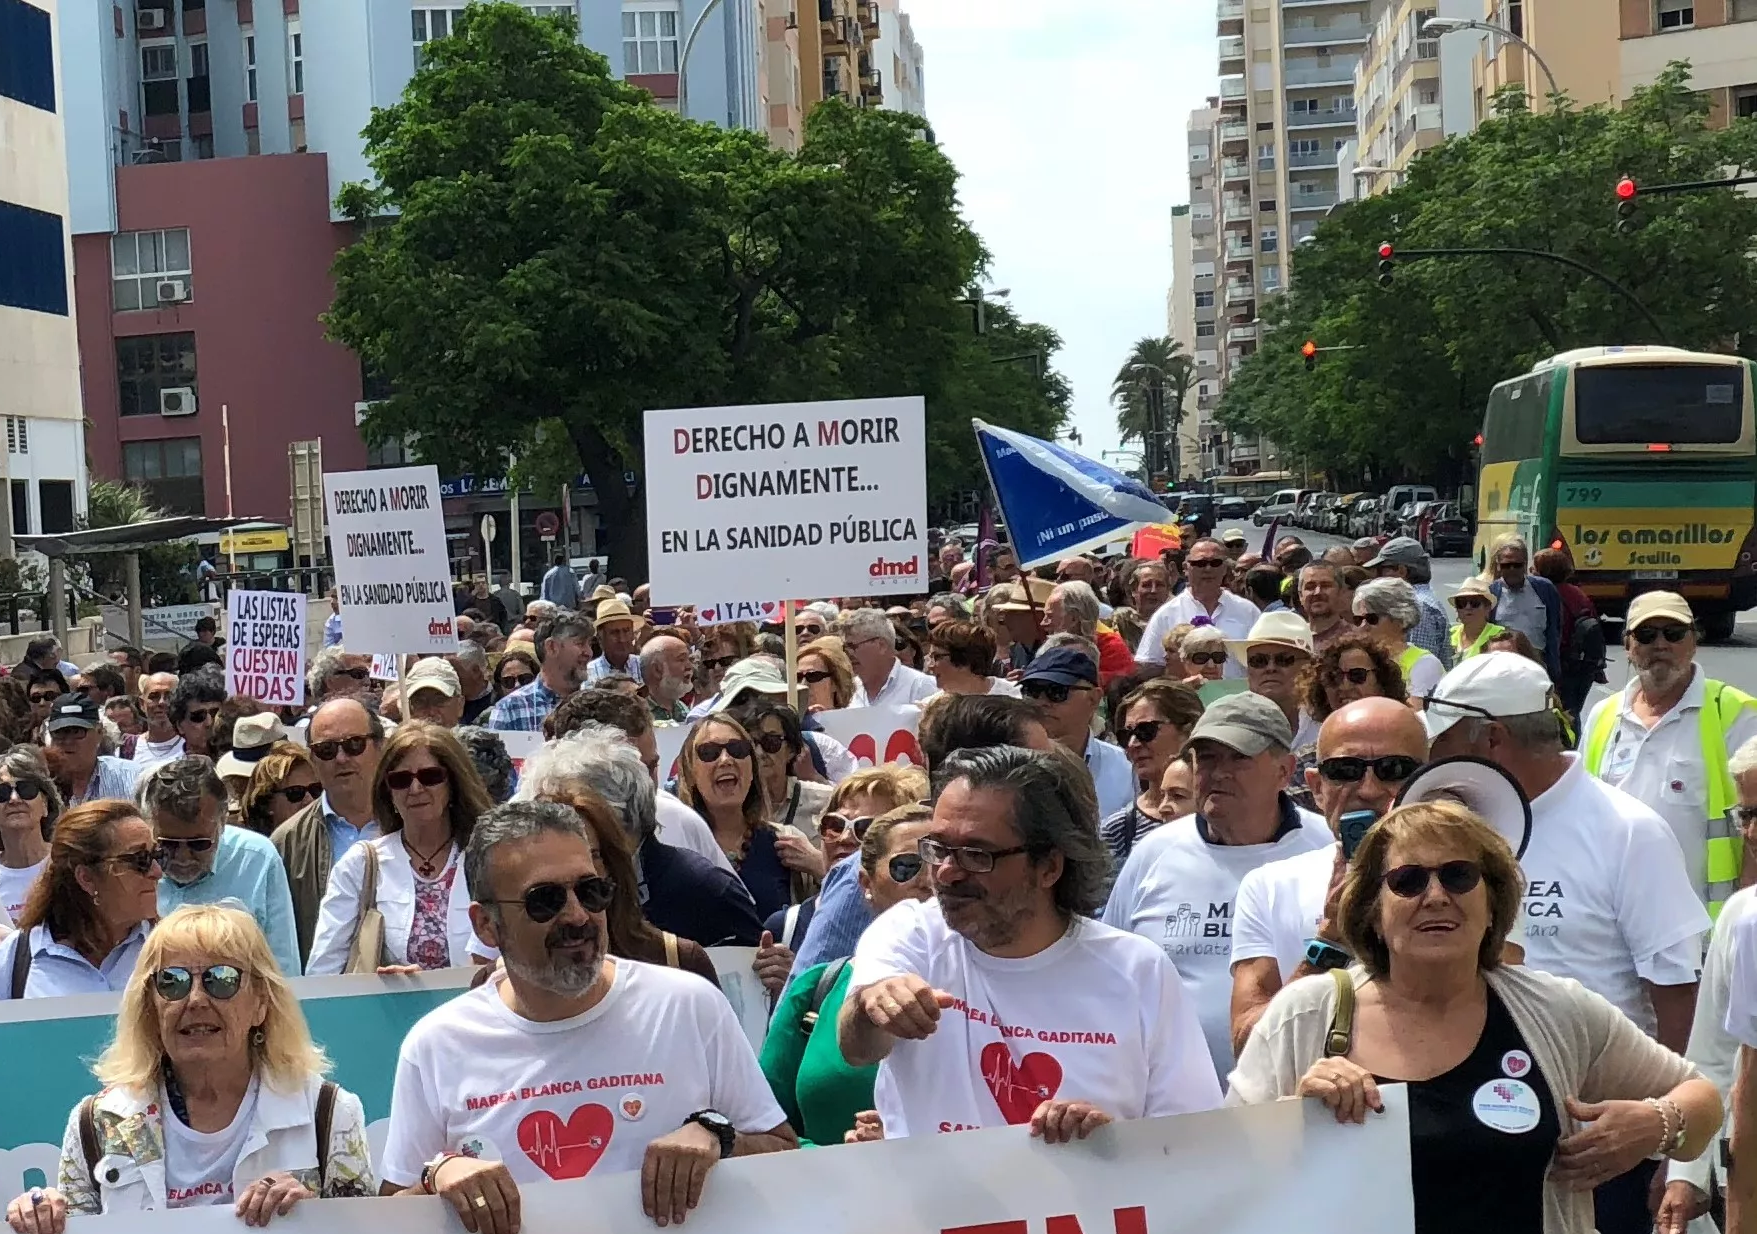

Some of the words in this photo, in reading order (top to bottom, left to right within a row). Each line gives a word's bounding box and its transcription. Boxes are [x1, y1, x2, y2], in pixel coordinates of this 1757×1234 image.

[673, 423, 785, 455] DERECHO
[793, 422, 811, 448] A
[818, 417, 900, 447] MORIR
[696, 466, 879, 500] DIGNAMENTE...
[1566, 487, 1602, 502] 799
[334, 488, 377, 514] DERECHO
[380, 489, 389, 512] A
[389, 485, 430, 511] MORIR
[661, 529, 689, 553] EN
[695, 528, 721, 552] LA
[726, 522, 823, 550] SANIDAD
[830, 514, 918, 545] PÚBLICA
[1057, 521, 1076, 537] un
[1574, 523, 1610, 545] los
[1617, 523, 1735, 545] amarillos
[347, 530, 425, 558] DIGNAMENTE...
[1628, 550, 1682, 565] Sevilla
[869, 555, 918, 577] dmd
[341, 584, 351, 605] EN
[352, 584, 363, 605] LA
[364, 583, 404, 605] SANIDAD
[405, 576, 449, 604] PÚBLICA
[237, 595, 258, 620] LAS
[260, 596, 297, 622] LISTAS
[232, 621, 247, 646] DE
[252, 622, 300, 649] ESPERAS
[428, 616, 453, 635] dmd
[233, 648, 298, 675] CUESTAN
[233, 674, 296, 701] VIDAS
[1037, 1030, 1118, 1045] GADITANA
[466, 1091, 517, 1111] MAREA
[520, 1080, 583, 1101] BLANCA
[587, 1072, 665, 1090] GADITANA
[168, 1182, 223, 1200] BLANCA
